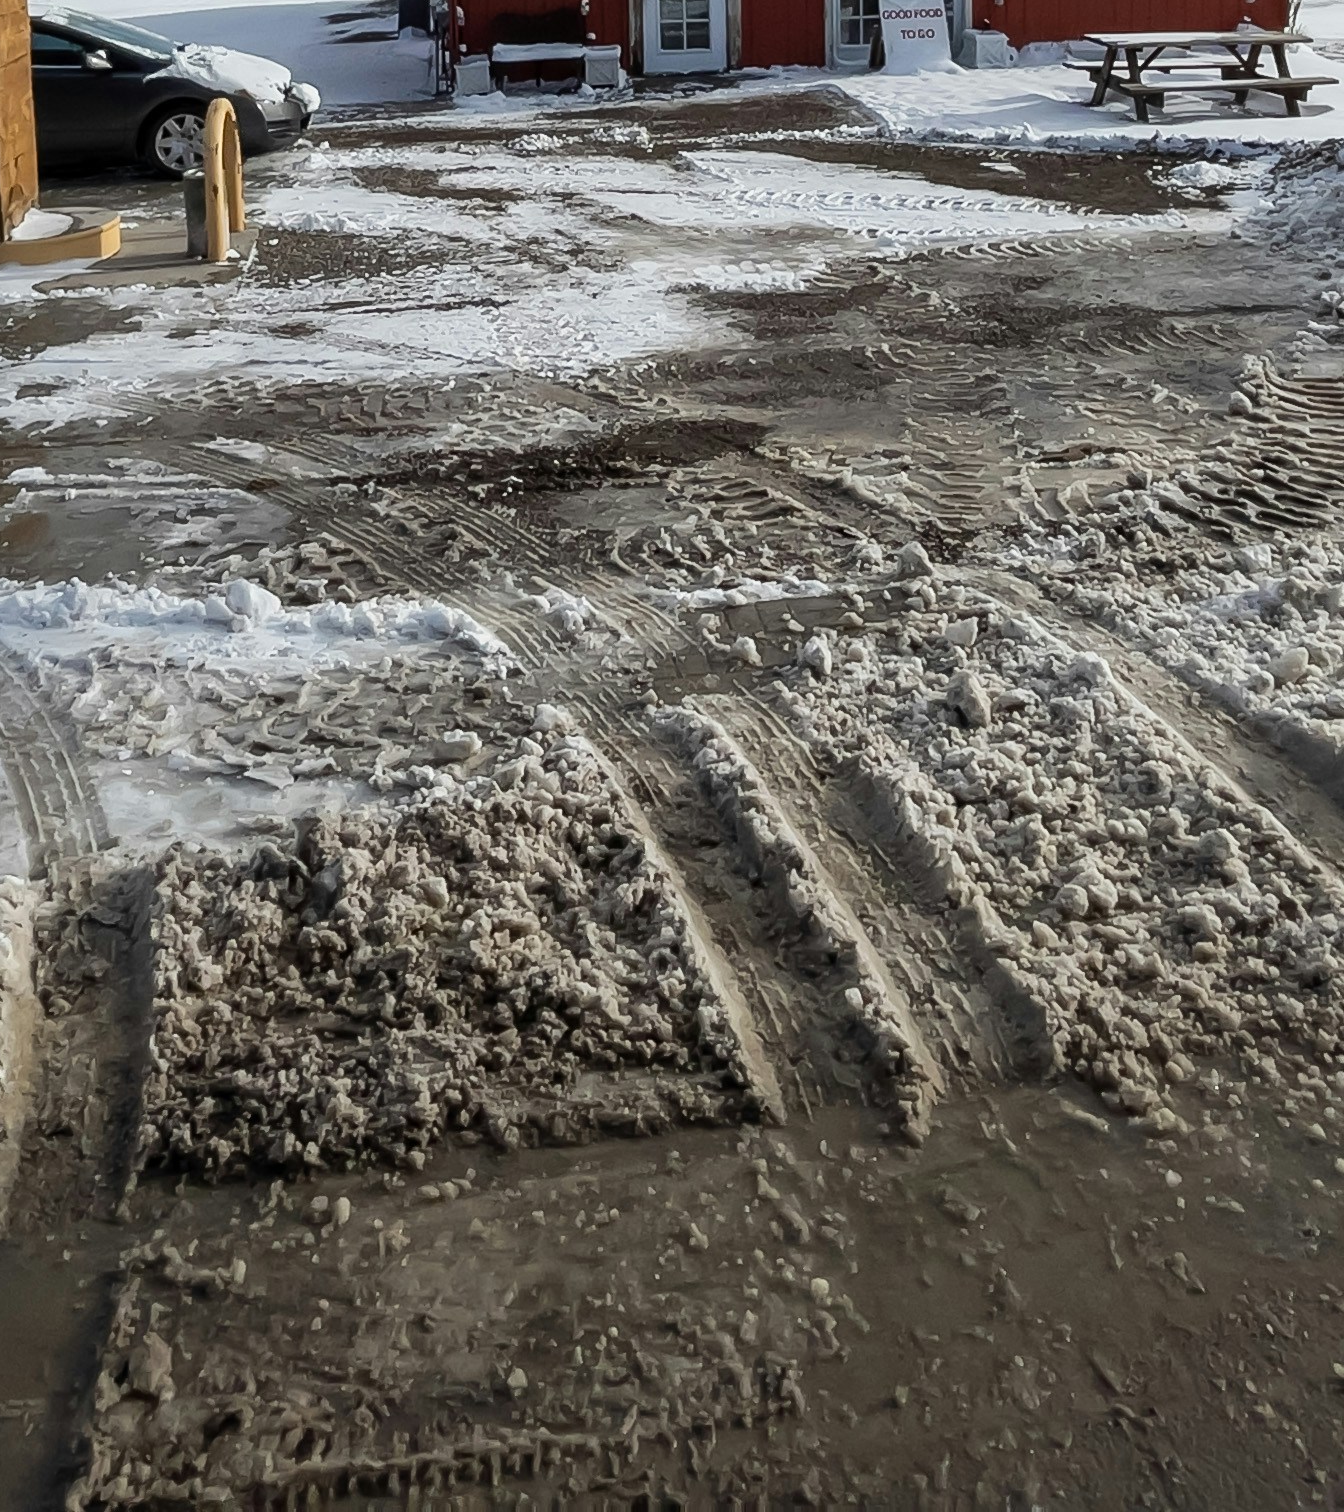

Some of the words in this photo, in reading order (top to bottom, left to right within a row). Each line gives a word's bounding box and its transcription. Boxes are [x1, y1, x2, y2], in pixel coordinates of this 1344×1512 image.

[882, 9, 913, 20] GOOD
[914, 8, 943, 19] FOOD
[900, 29, 916, 39] TO
[918, 28, 935, 39] GO
